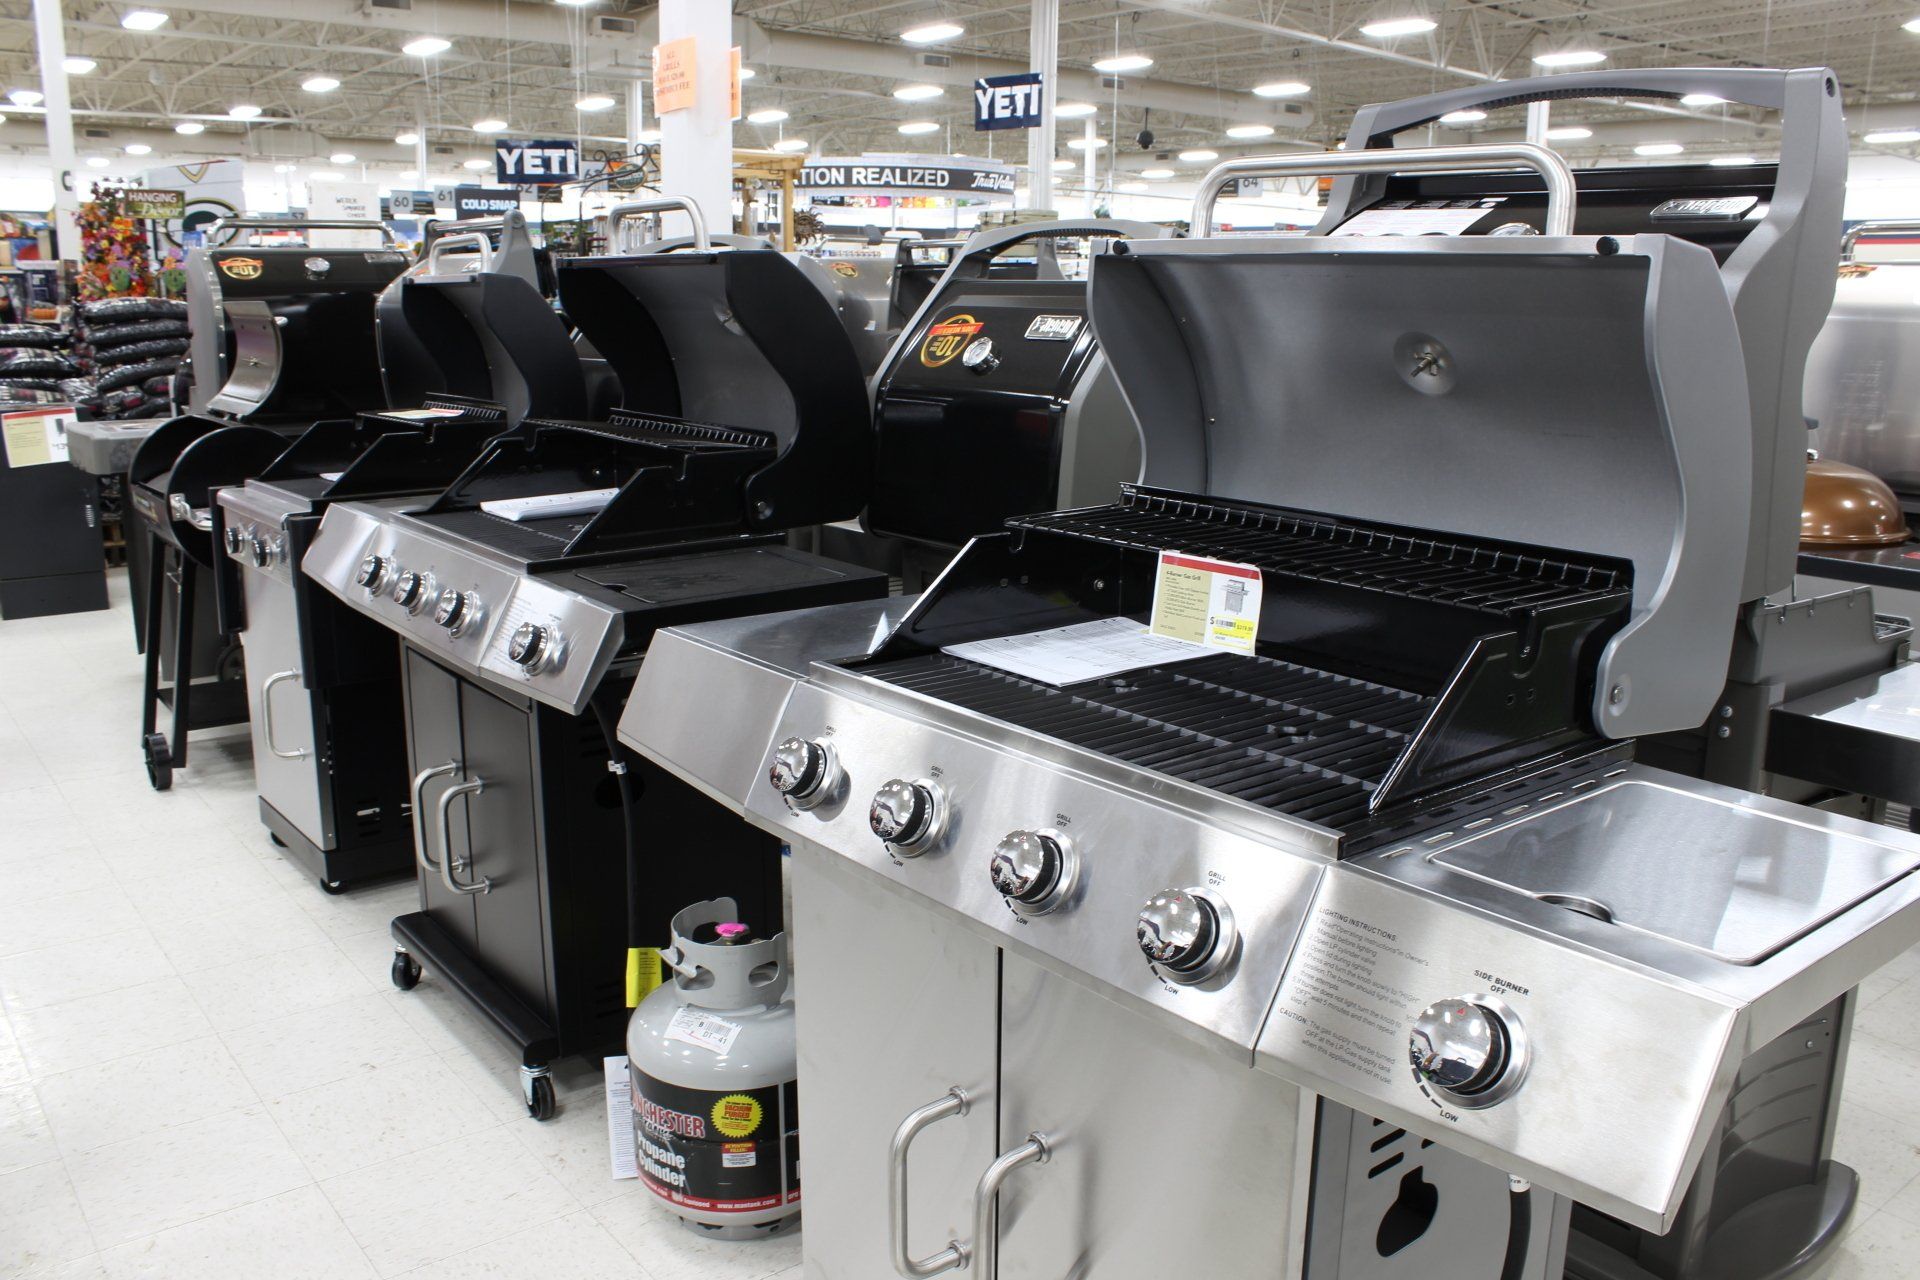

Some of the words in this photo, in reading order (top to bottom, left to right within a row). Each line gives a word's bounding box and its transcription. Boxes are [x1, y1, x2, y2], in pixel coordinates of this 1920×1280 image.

[975, 83, 1040, 120] YETI
[498, 148, 578, 175] YETI
[793, 168, 845, 186] TION
[852, 168, 950, 188] REALIZED
[128, 192, 177, 203] HANGING
[394, 196, 410, 208] 60
[438, 190, 453, 201] 61
[462, 198, 489, 210] COLD
[490, 199, 518, 210] SNAP
[940, 336, 960, 356] 10
[1056, 812, 1072, 824] GRILL
[1056, 820, 1068, 828] OFF
[894, 859, 904, 867] LOW
[1208, 870, 1226, 882] GRILL
[1208, 878, 1222, 887] OFF
[1016, 916, 1028, 926] LOW
[1318, 906, 1348, 922] LIGHTING
[1338, 935, 1356, 948] before
[1338, 946, 1360, 960] cylinder
[1333, 954, 1352, 968] during
[1306, 952, 1323, 964] Press
[1334, 964, 1348, 974] turn
[1358, 973, 1372, 985] knob
[1337, 976, 1356, 988] burner
[1356, 984, 1376, 996] should
[1474, 969, 1494, 982] SIDE
[1494, 978, 1530, 996] BURNER
[1164, 984, 1179, 996] LOW
[1490, 984, 1508, 996] OFF
[1320, 986, 1334, 998] does
[1380, 1014, 1394, 1024] knob
[1327, 1002, 1350, 1016] minutes
[1350, 1012, 1362, 1022] and
[1362, 1016, 1376, 1027] then
[1376, 1022, 1396, 1037] repeat
[1305, 1029, 1320, 1039] OFF
[1358, 1054, 1377, 1068] supply
[1310, 1020, 1320, 1031] The
[1332, 1032, 1351, 1046] supply
[1352, 1040, 1368, 1051] must
[1375, 1051, 1396, 1064] turned
[1302, 1039, 1318, 1052] when
[1328, 1052, 1356, 1070] appliance
[1440, 1109, 1459, 1123] LOW
[638, 1129, 686, 1170] Propane
[638, 1148, 686, 1188] Cylinder
